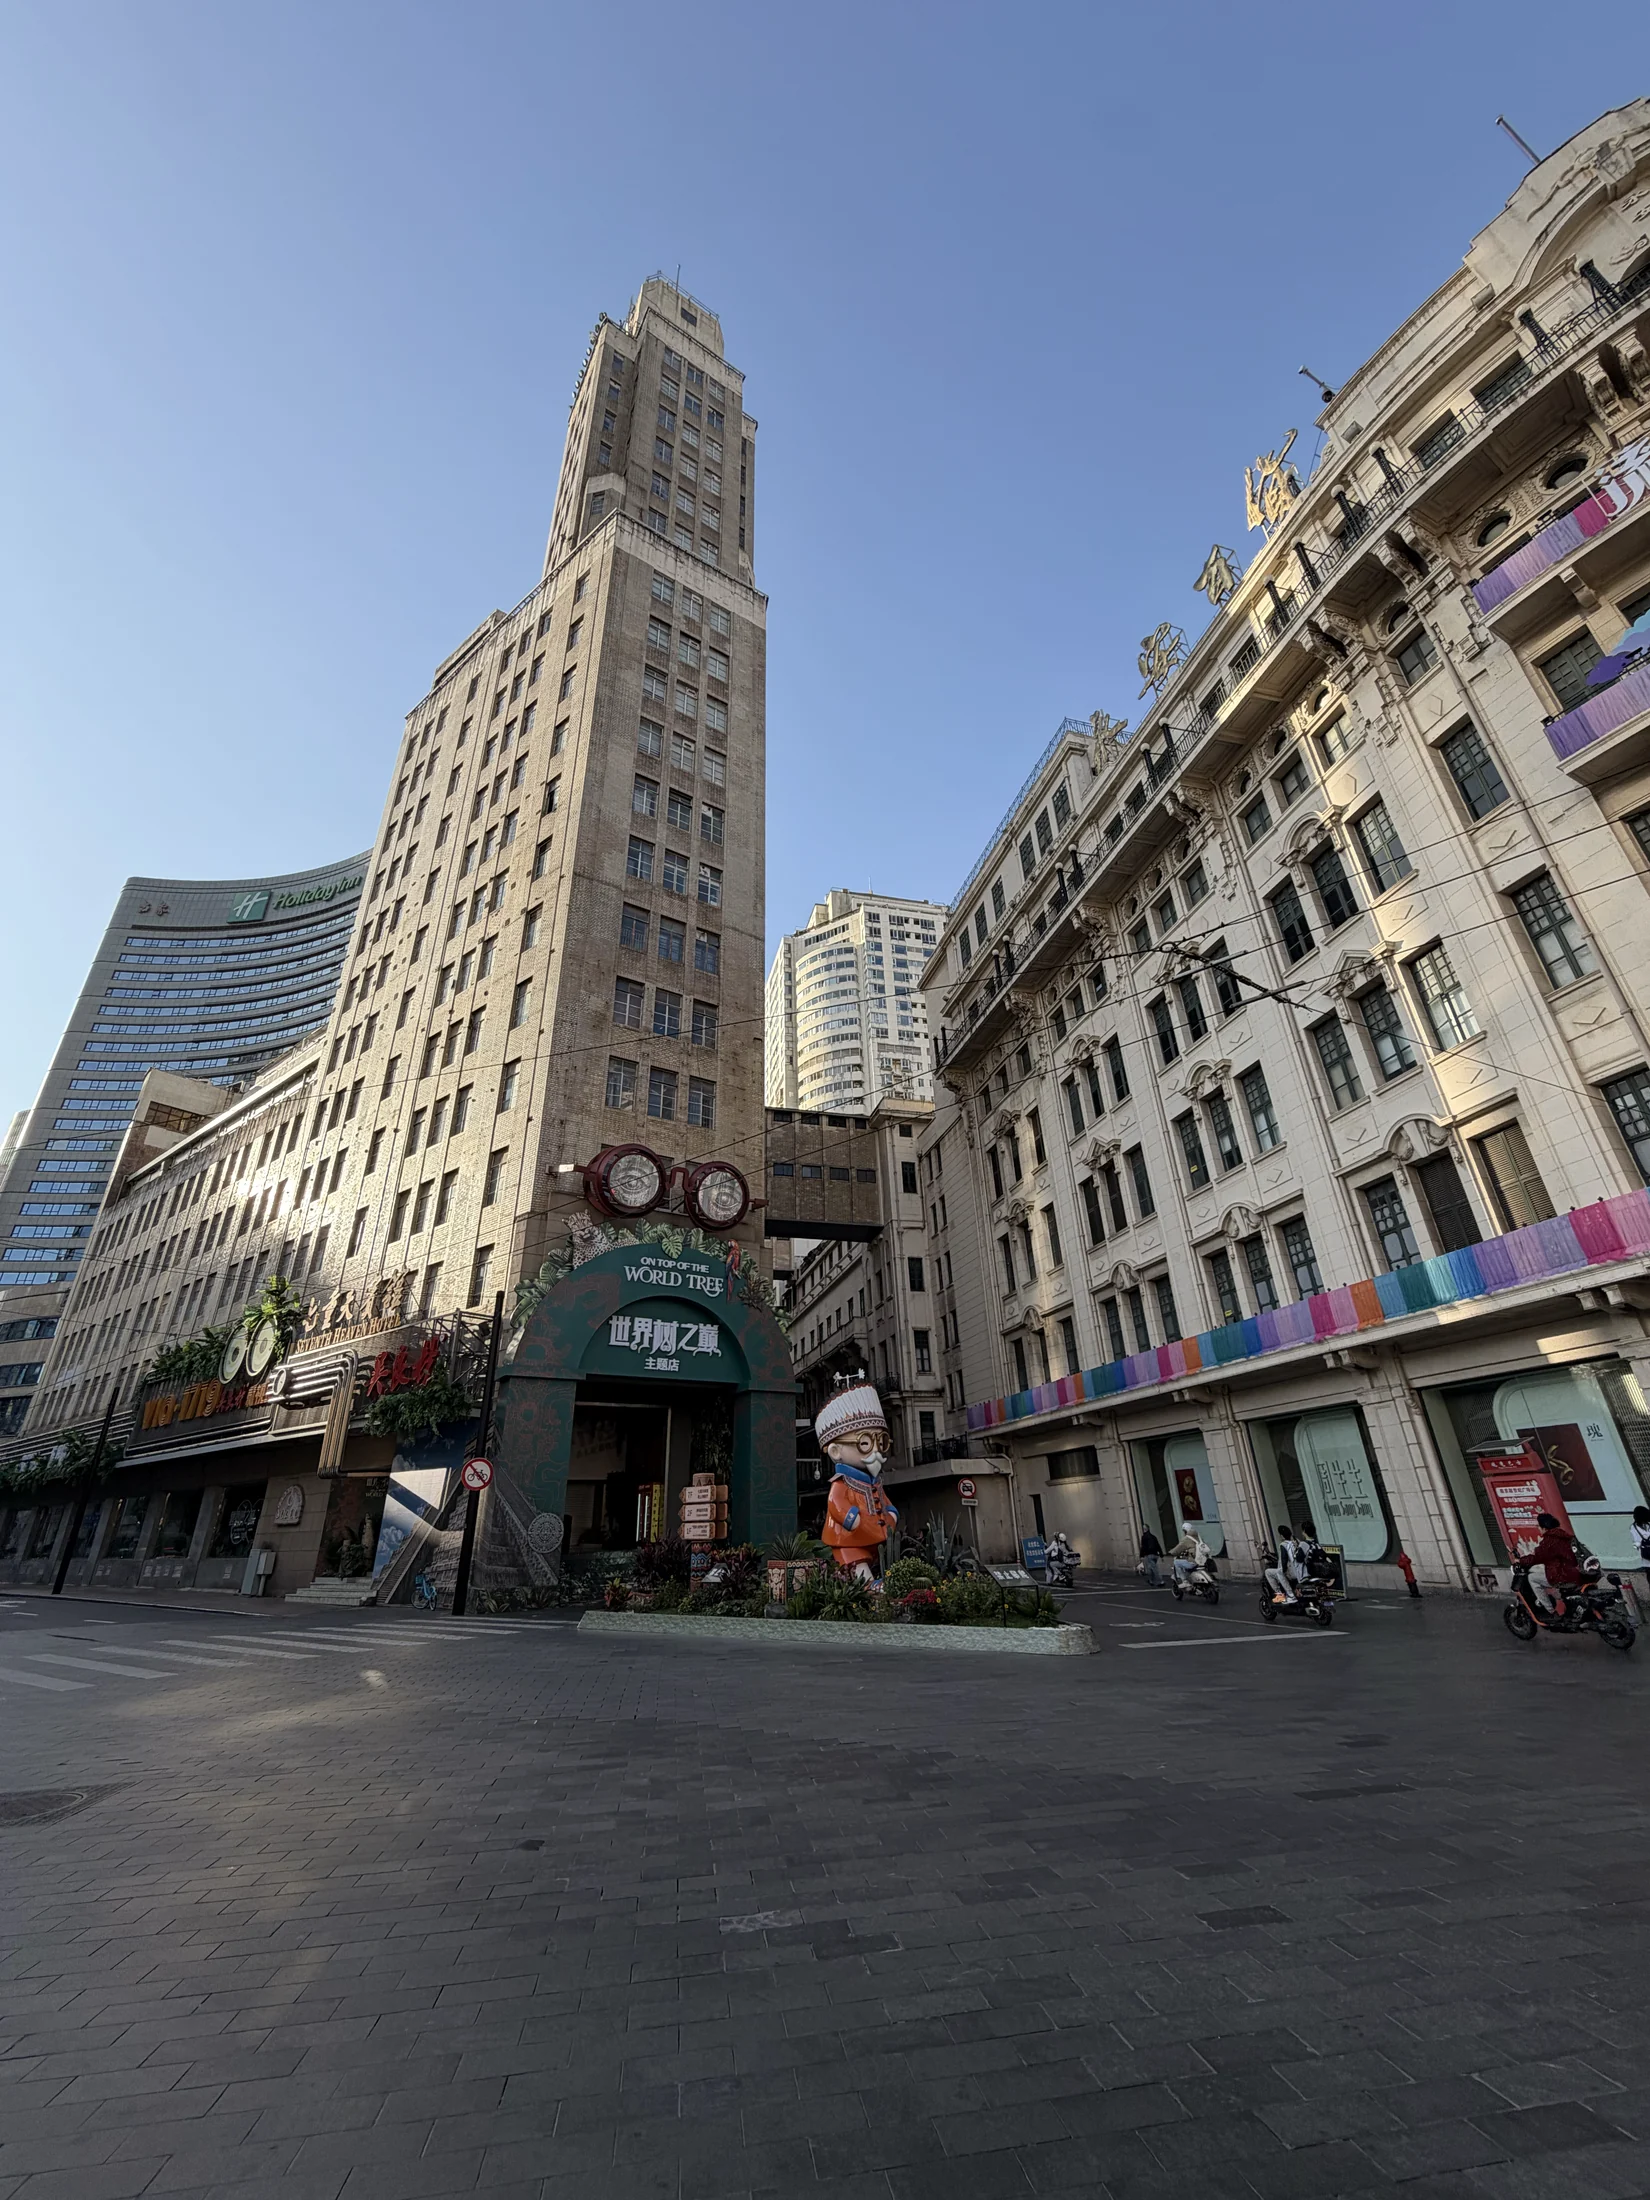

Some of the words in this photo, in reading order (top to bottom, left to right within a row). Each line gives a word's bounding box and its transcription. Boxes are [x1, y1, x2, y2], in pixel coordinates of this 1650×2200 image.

[272, 883, 337, 911] Holiday
[336, 874, 362, 894] Inn
[623, 1265, 683, 1287] WORLD
[685, 1273, 724, 1297] TREE
[640, 1256, 656, 1267] ON
[657, 1258, 677, 1269] TOP
[677, 1261, 690, 1271] OF
[689, 1263, 710, 1273] THE
[296, 1331, 333, 1353] SEVENTH
[332, 1322, 370, 1344] HEAVEN
[369, 1314, 401, 1335] HOTEL
[608, 1314, 722, 1357] 世界树之巅
[643, 1357, 680, 1372] 主题店
